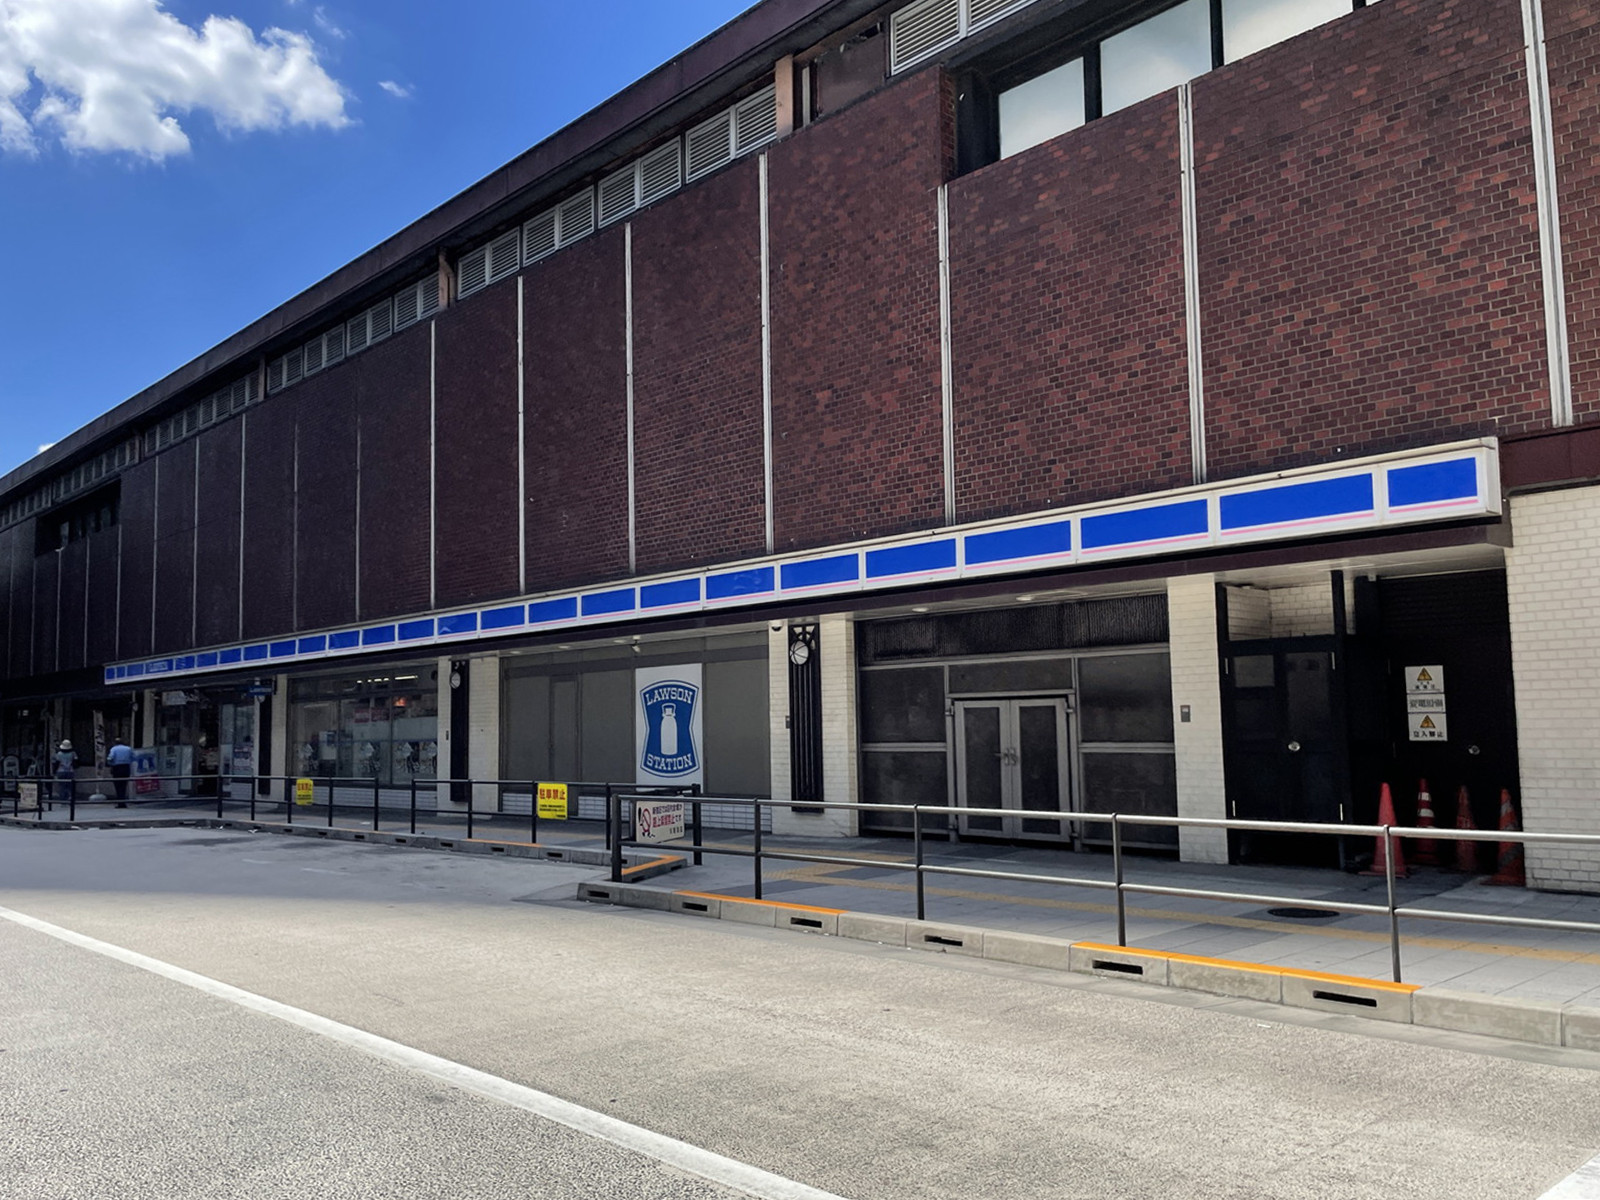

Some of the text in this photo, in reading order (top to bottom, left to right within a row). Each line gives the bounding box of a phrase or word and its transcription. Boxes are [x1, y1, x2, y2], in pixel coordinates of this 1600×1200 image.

[645, 687, 693, 705] LAWSON
[646, 754, 692, 771] STATION
[539, 789, 566, 800] 駐車禁止
